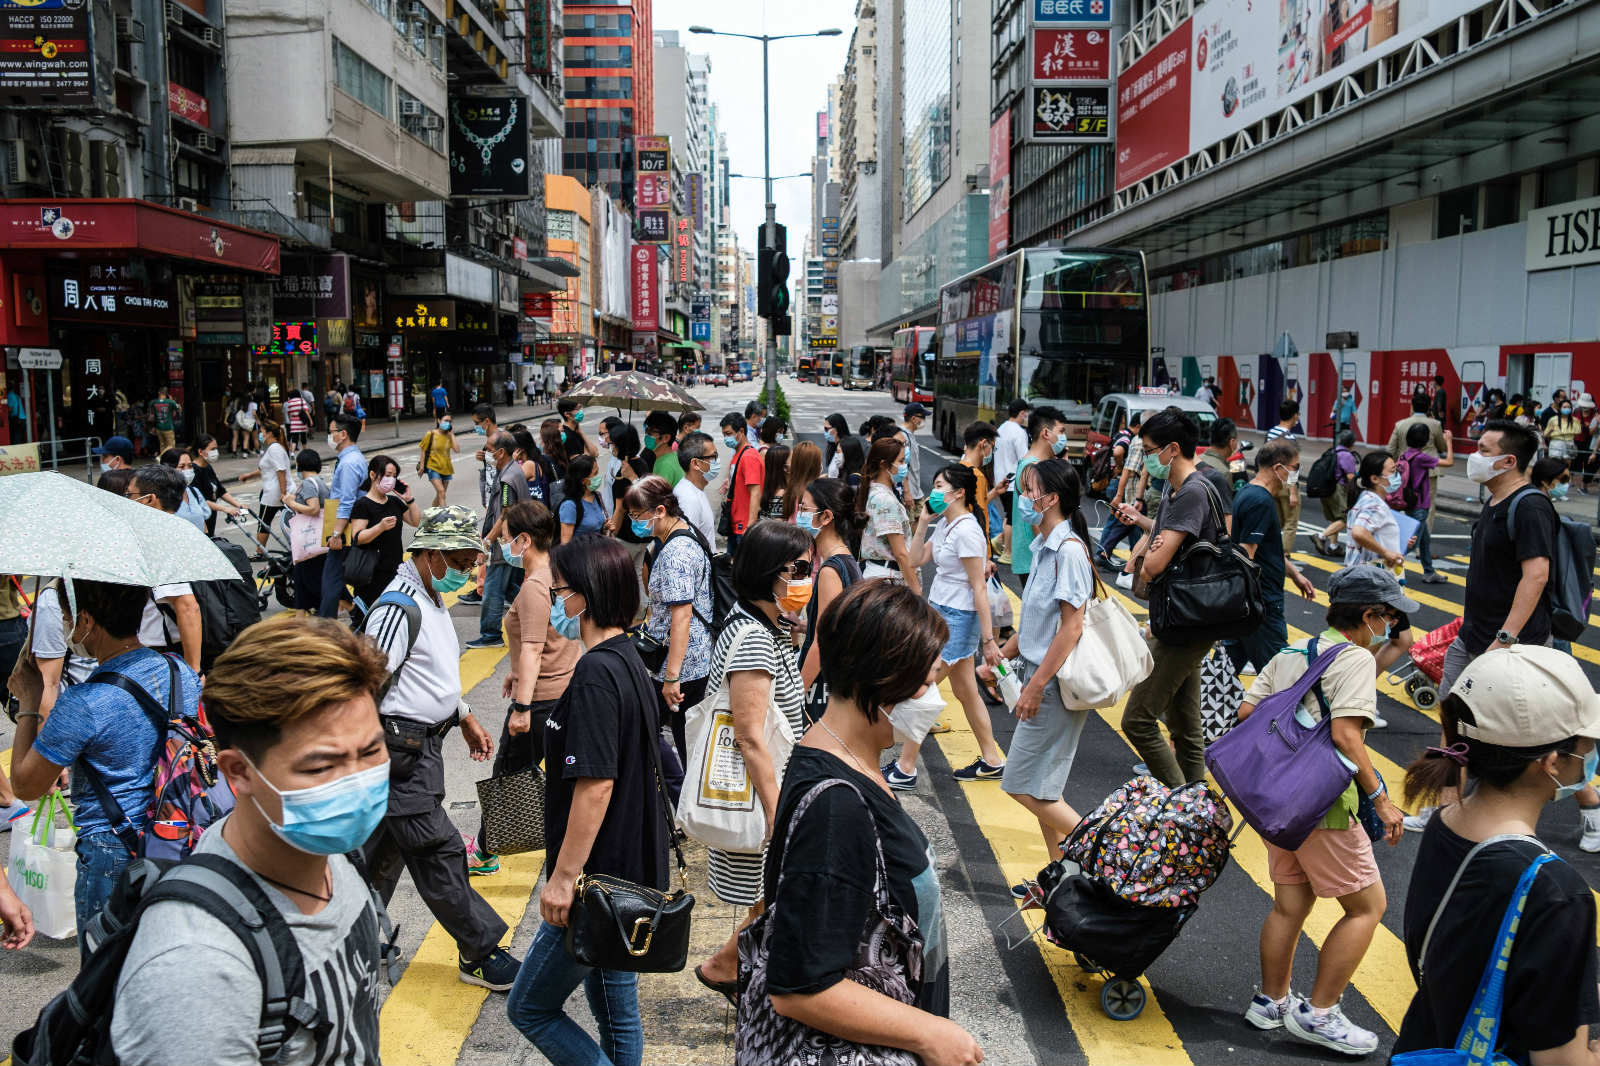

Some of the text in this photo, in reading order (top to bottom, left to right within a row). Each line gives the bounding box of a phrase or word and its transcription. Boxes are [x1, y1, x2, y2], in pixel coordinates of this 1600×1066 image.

[8, 15, 74, 23] HACCP ISO 22000
[0, 60, 88, 69] www.wingwah.com
[641, 159, 665, 169] 10/F
